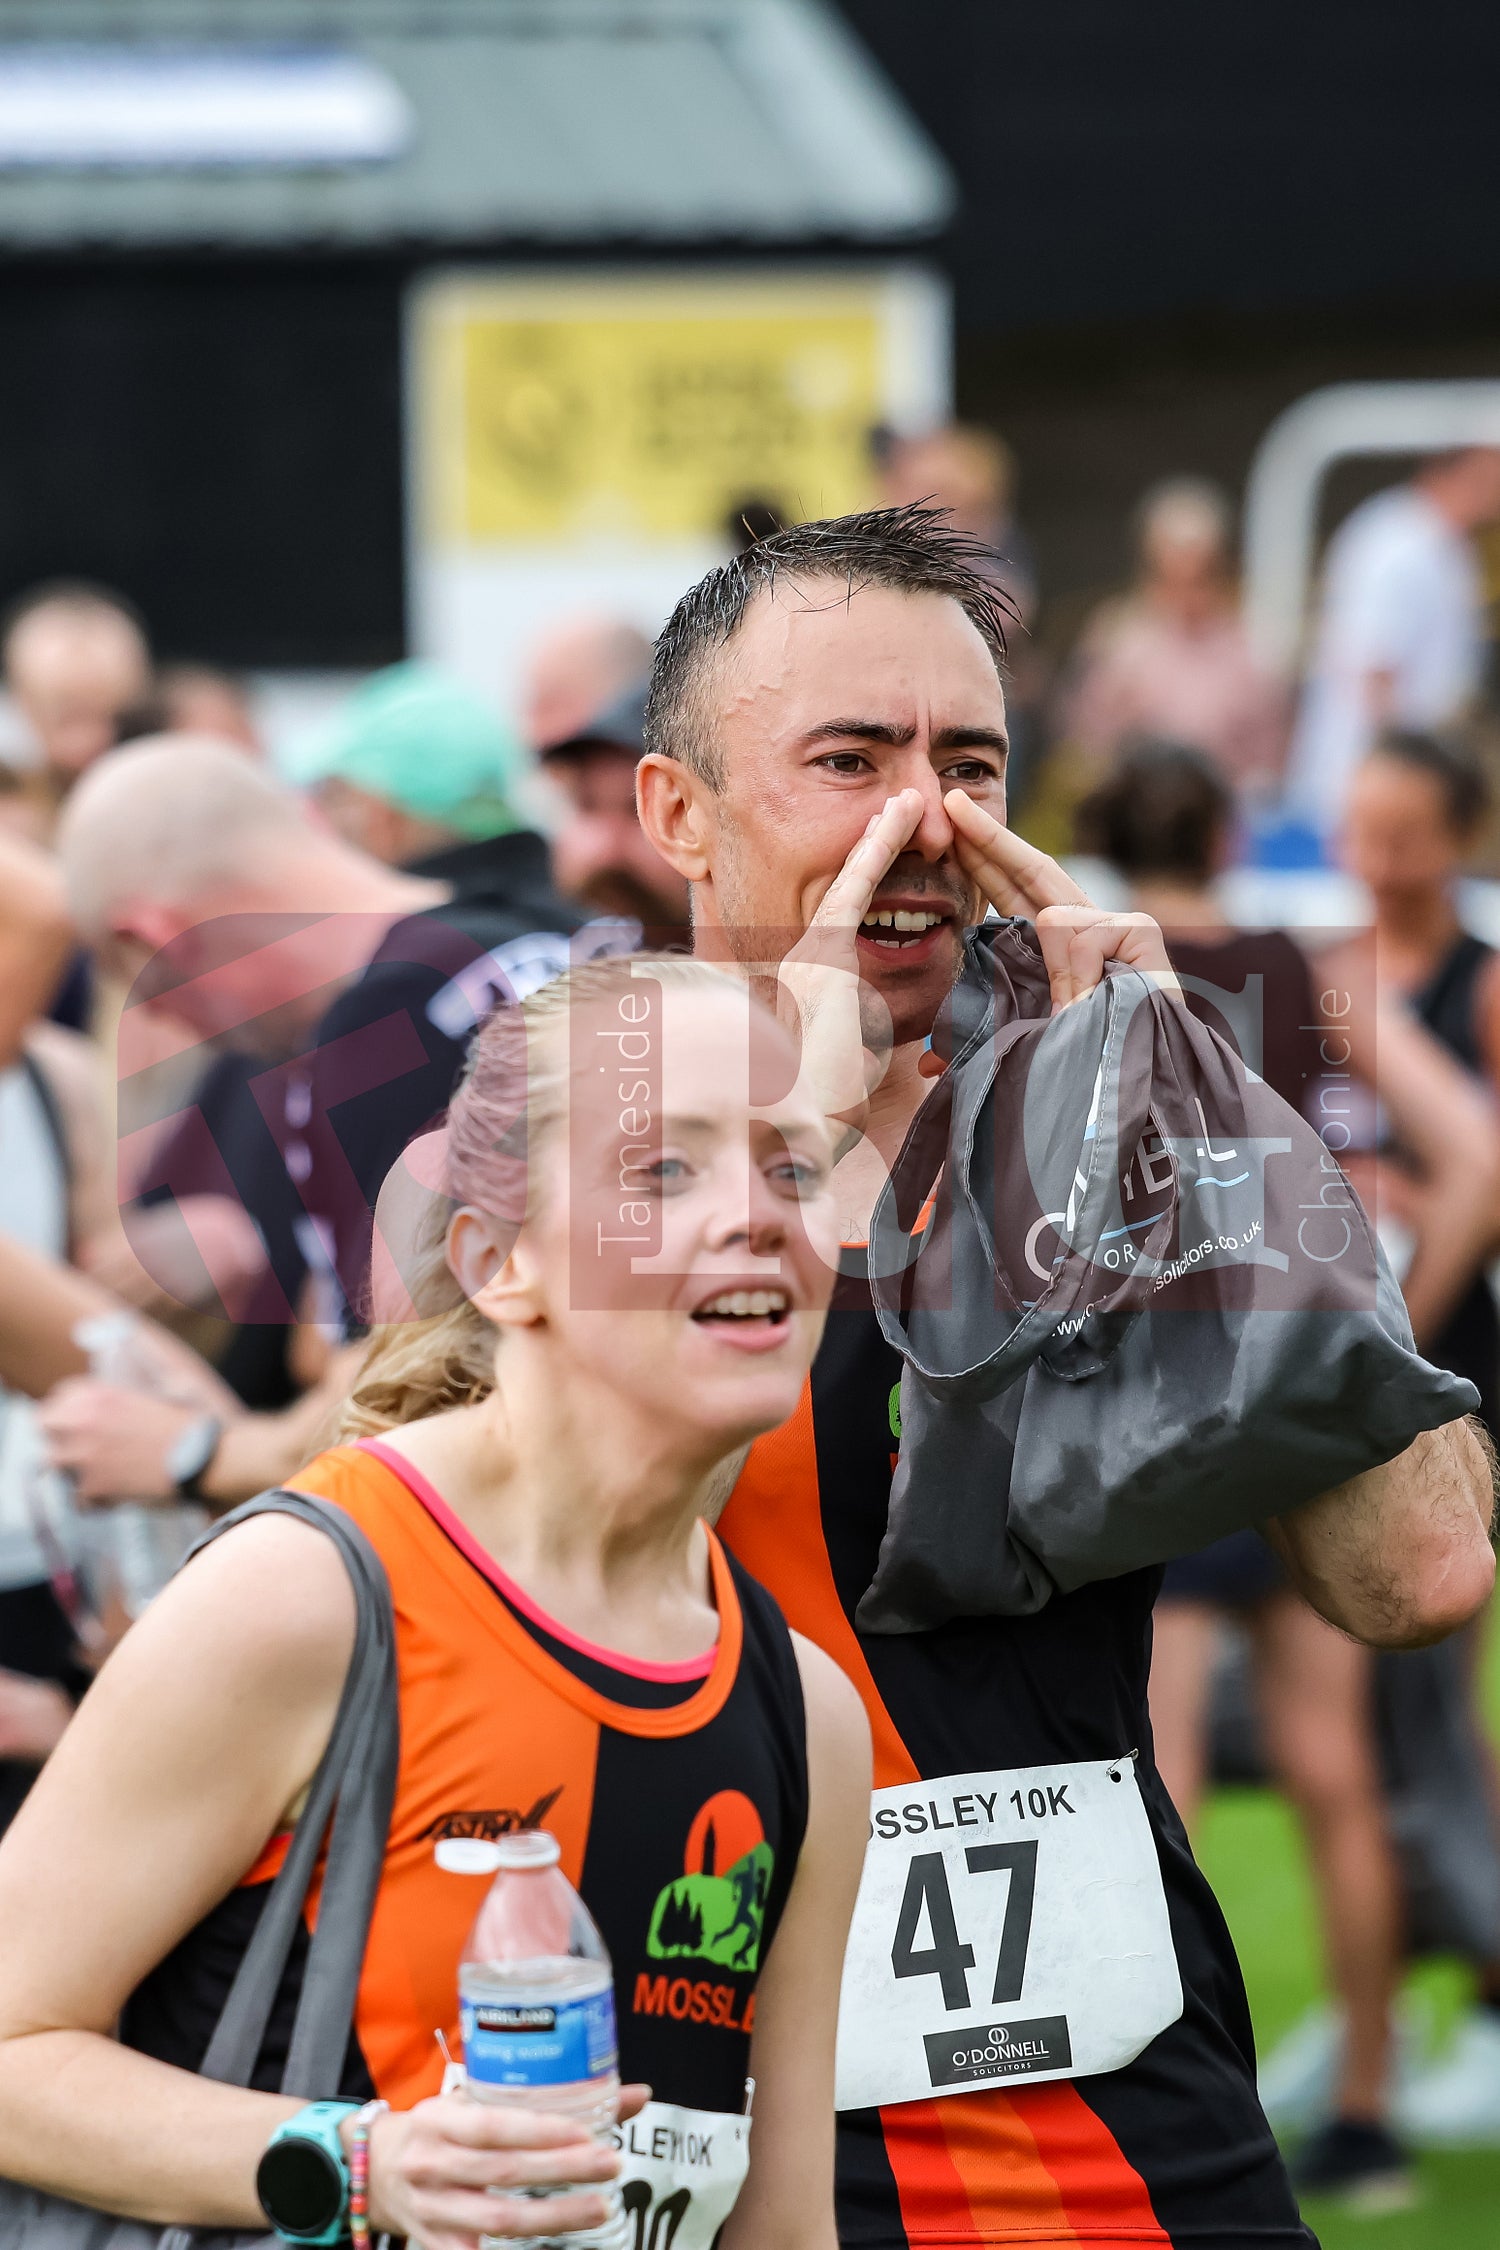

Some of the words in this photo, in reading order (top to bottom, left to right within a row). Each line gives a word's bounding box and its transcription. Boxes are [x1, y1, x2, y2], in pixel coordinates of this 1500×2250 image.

[868, 1792, 998, 1841] SSLEY
[1010, 1785, 1076, 1820] 10K
[891, 1839, 1039, 2012] 47
[952, 2039, 1050, 2067] O'DONNELL
[972, 2062, 1032, 2077] SOLICITORS
